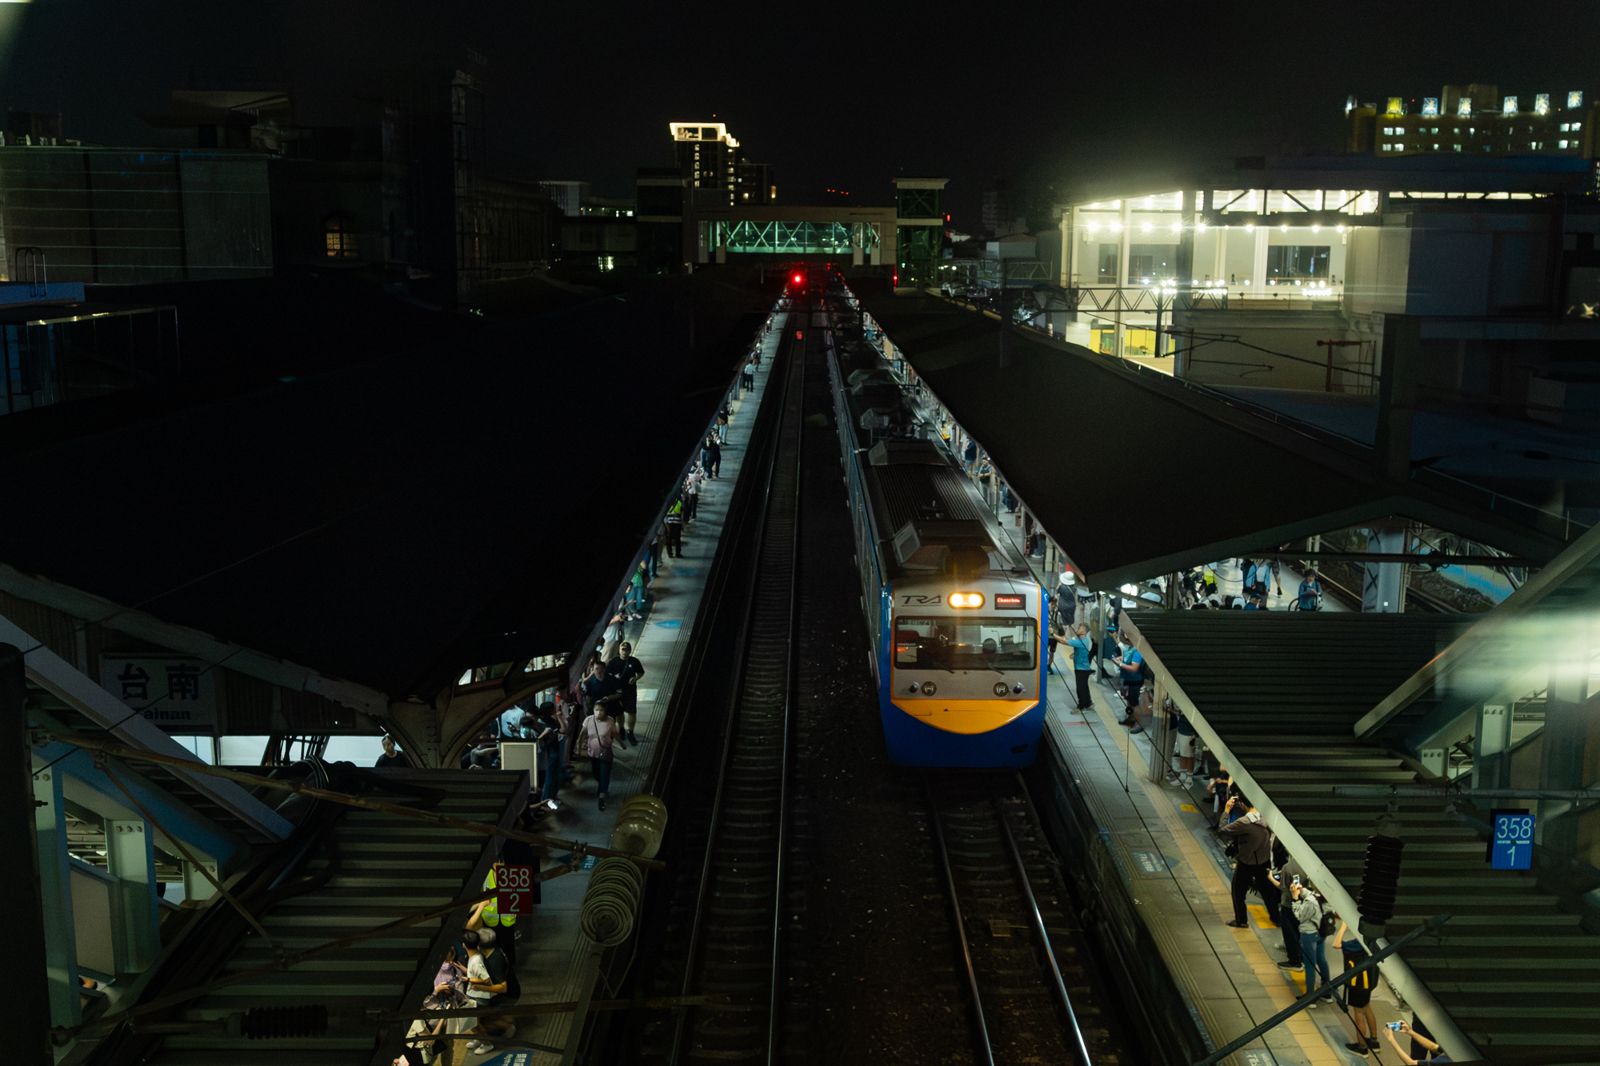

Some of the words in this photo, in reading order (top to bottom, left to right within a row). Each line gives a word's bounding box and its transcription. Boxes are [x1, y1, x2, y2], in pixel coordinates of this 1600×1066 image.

[901, 595, 942, 605] TRA
[118, 663, 200, 700] 台南
[141, 707, 191, 720] ainan
[1497, 817, 1532, 839] 358
[1507, 845, 1516, 867] 1
[498, 867, 530, 888] 358
[509, 893, 520, 912] 2
